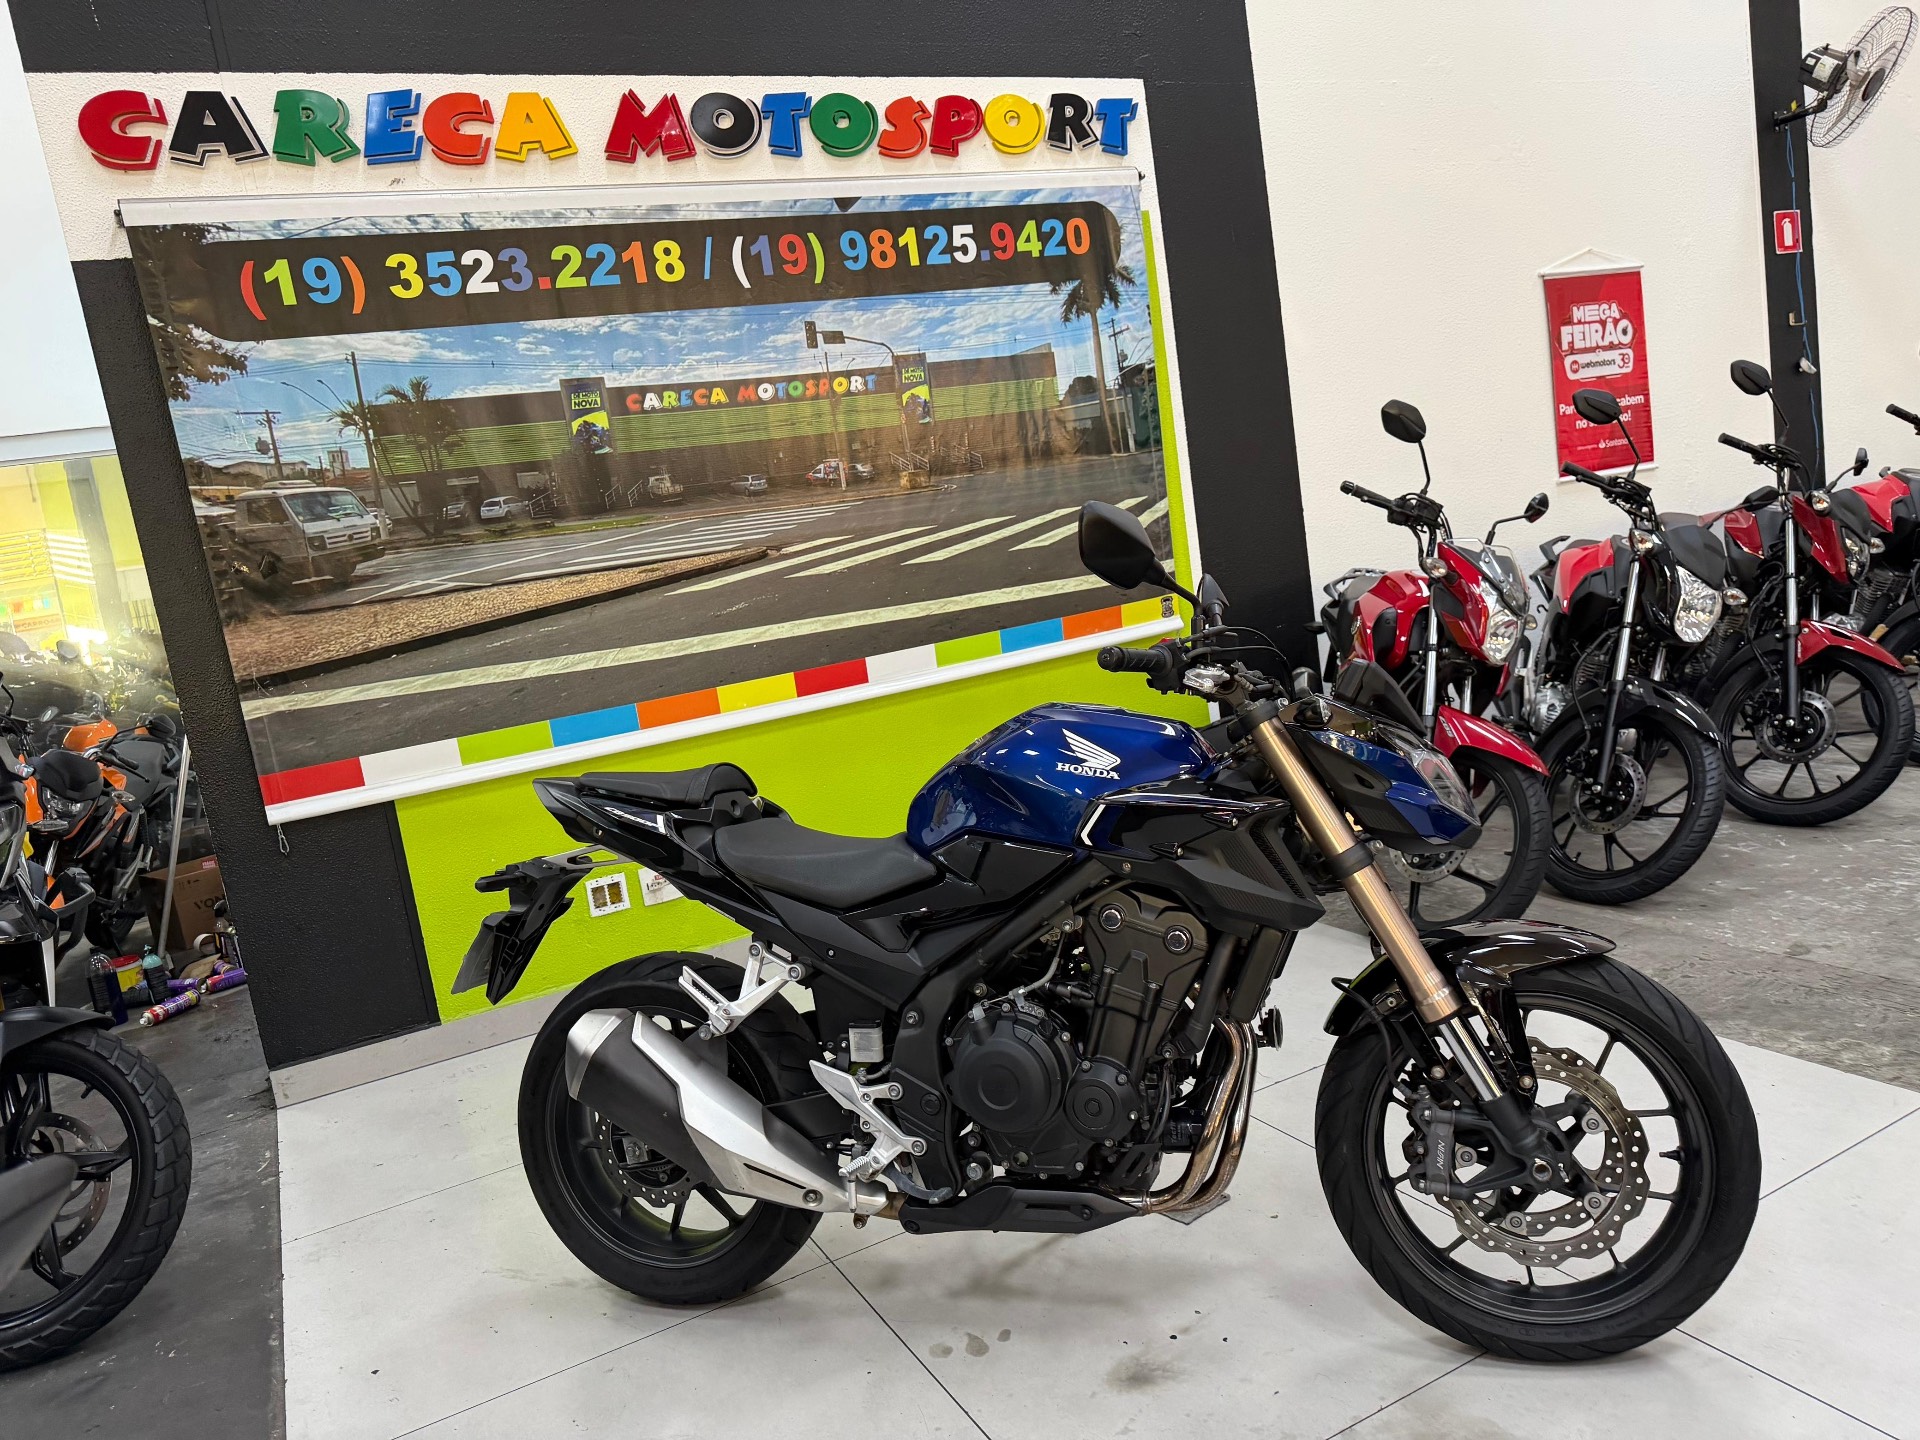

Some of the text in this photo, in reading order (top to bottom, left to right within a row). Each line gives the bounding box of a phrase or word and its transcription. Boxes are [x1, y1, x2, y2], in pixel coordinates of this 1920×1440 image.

[77, 87, 1139, 171] CARECA MOTOSPORT
[239, 217, 1090, 321] (19) 3523.2218 / (19) 98125.9420
[1572, 302, 1621, 323] MEGA
[1559, 317, 1634, 351] FEIRÃO
[1580, 358, 1616, 369] webmotors
[903, 373, 923, 382] NOVA
[625, 373, 878, 412] CARECA MOTOSPORT
[573, 399, 599, 409] NOVA
[1575, 419, 1588, 429] no
[1055, 762, 1121, 780] HONDA
